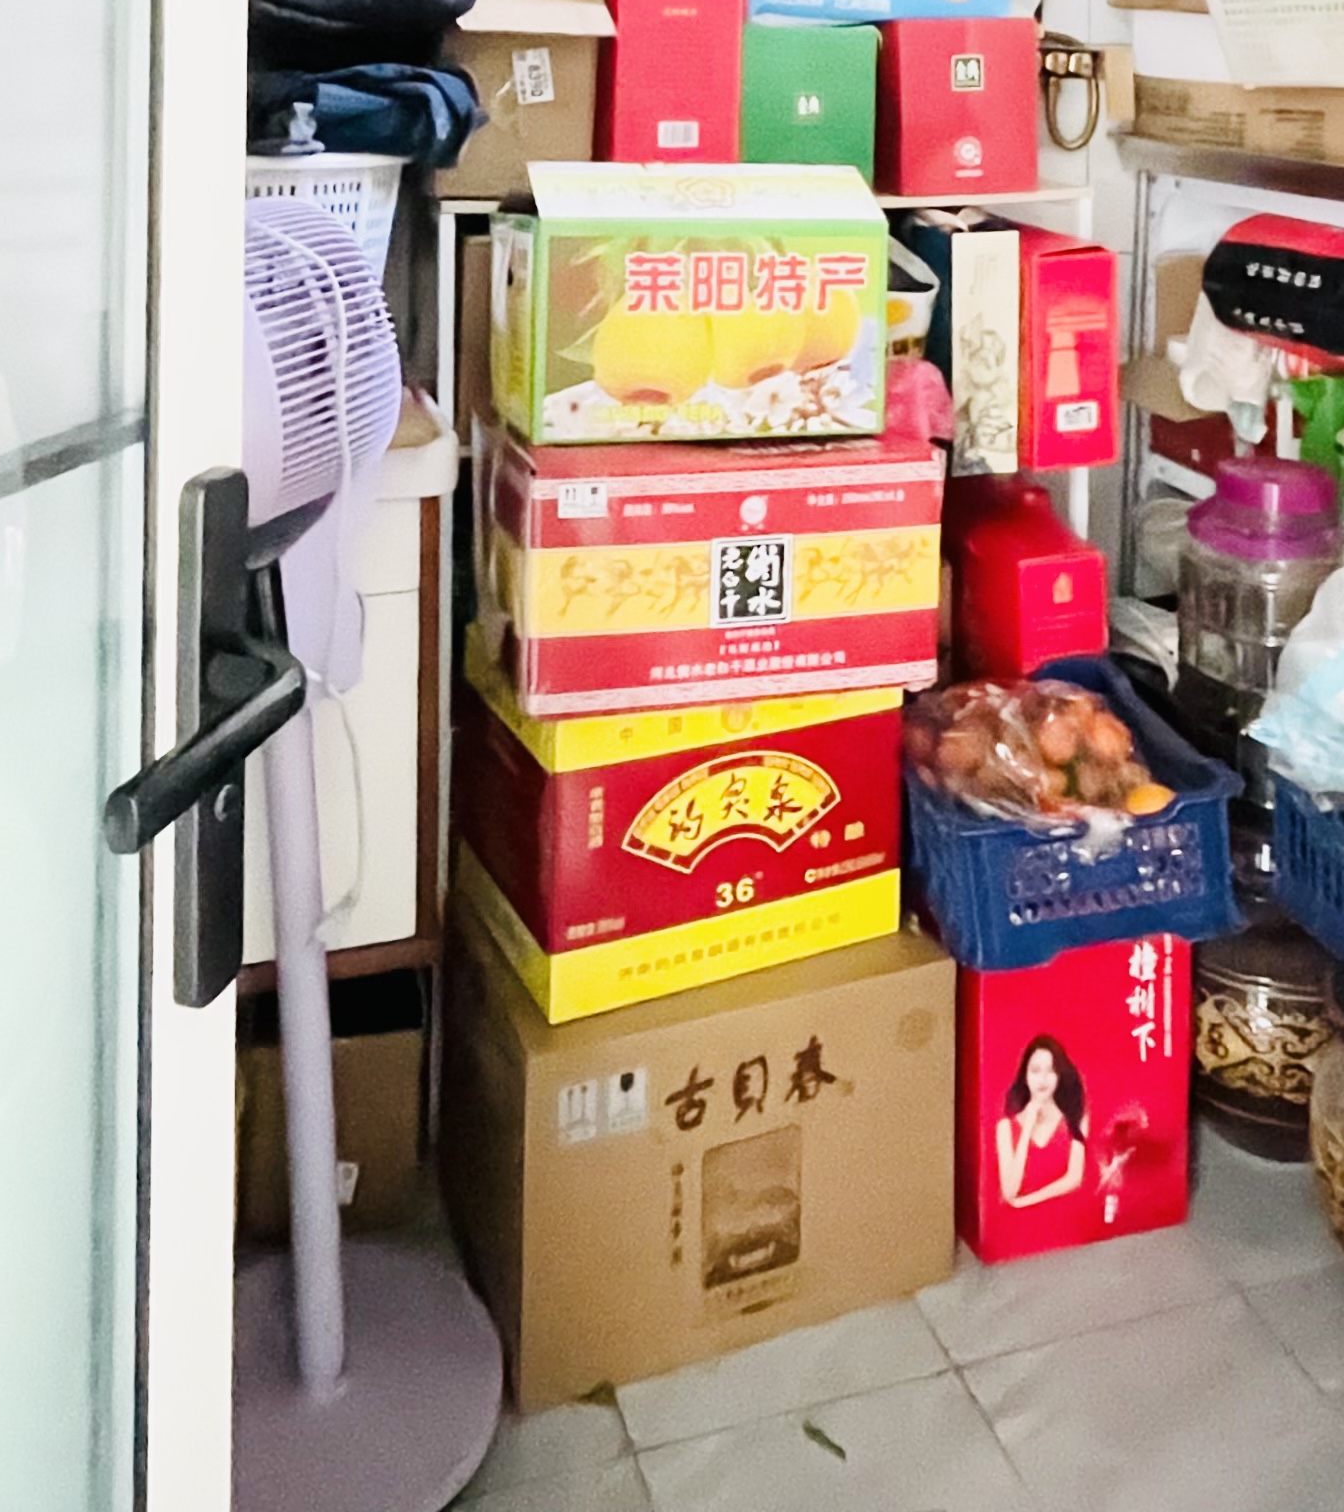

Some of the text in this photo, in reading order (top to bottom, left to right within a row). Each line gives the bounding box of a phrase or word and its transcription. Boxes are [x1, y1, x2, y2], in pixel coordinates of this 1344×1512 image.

[625, 251, 869, 314] 莱阳特产
[663, 1032, 839, 1132] 古贝春
